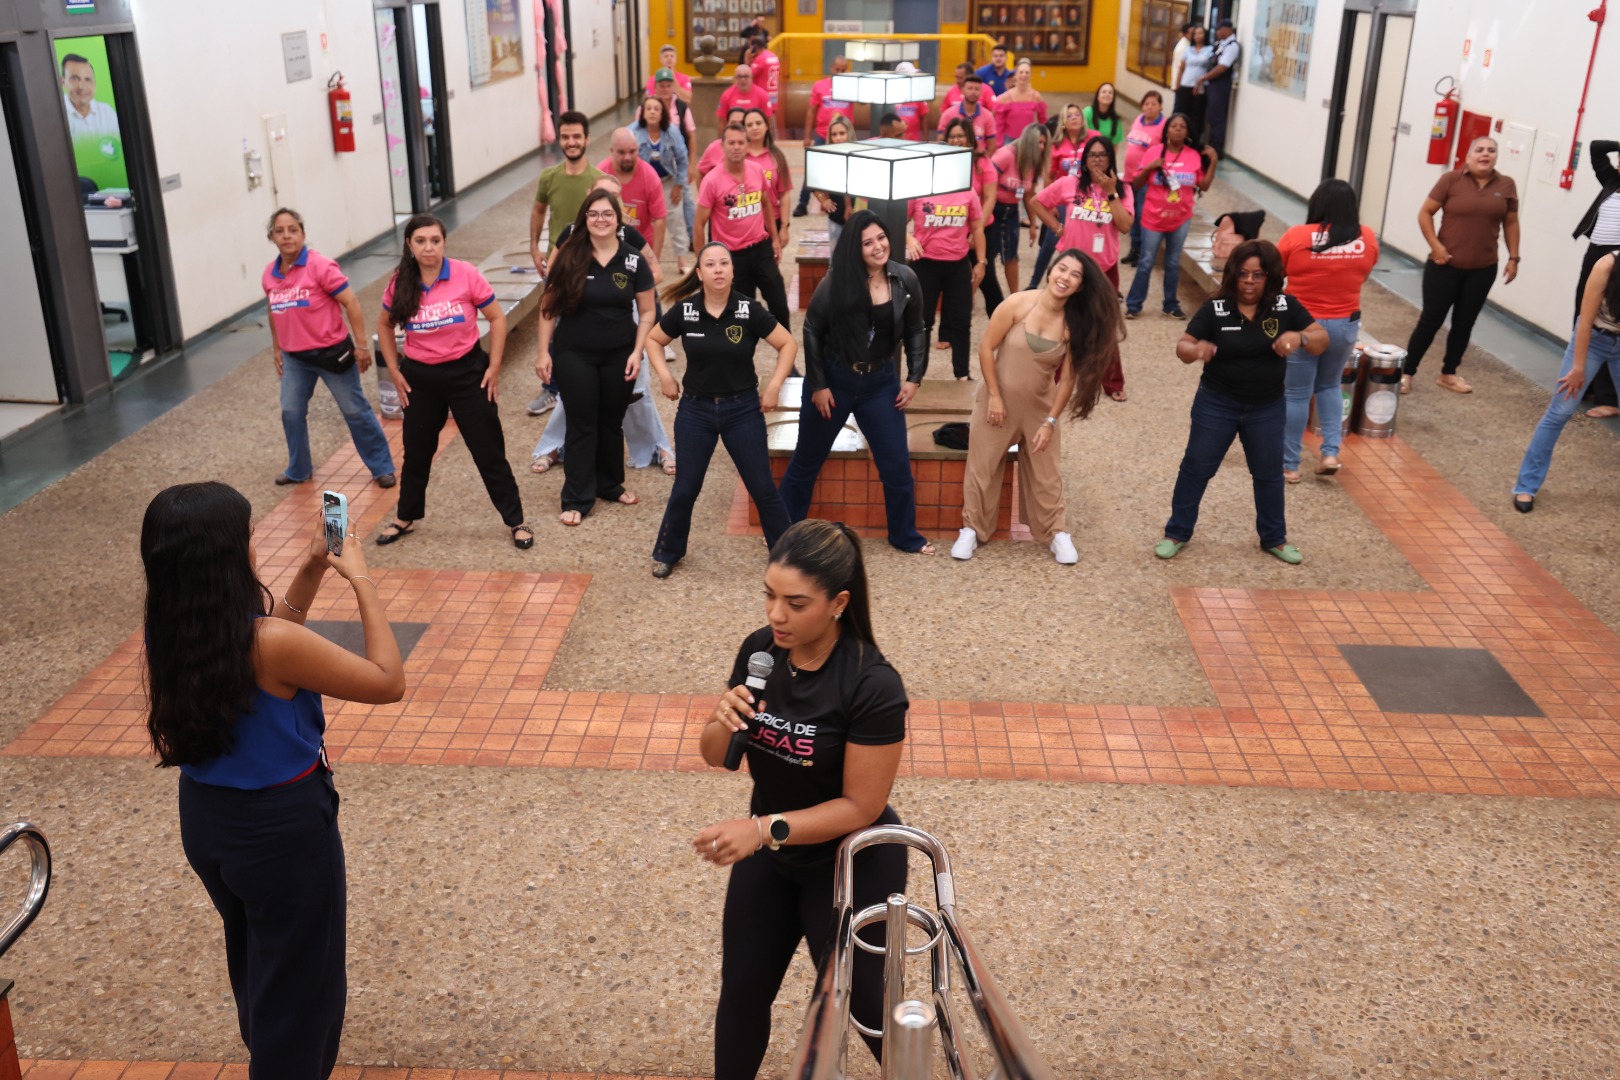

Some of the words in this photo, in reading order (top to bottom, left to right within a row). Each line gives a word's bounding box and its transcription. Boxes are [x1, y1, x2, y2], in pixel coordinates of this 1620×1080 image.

[935, 204, 967, 216] LIZA
[924, 214, 967, 227] PRADO
[410, 300, 464, 322] ngela
[421, 317, 454, 329] POSTINHO
[753, 711, 792, 733] BRICA
[793, 723, 817, 737] DE
